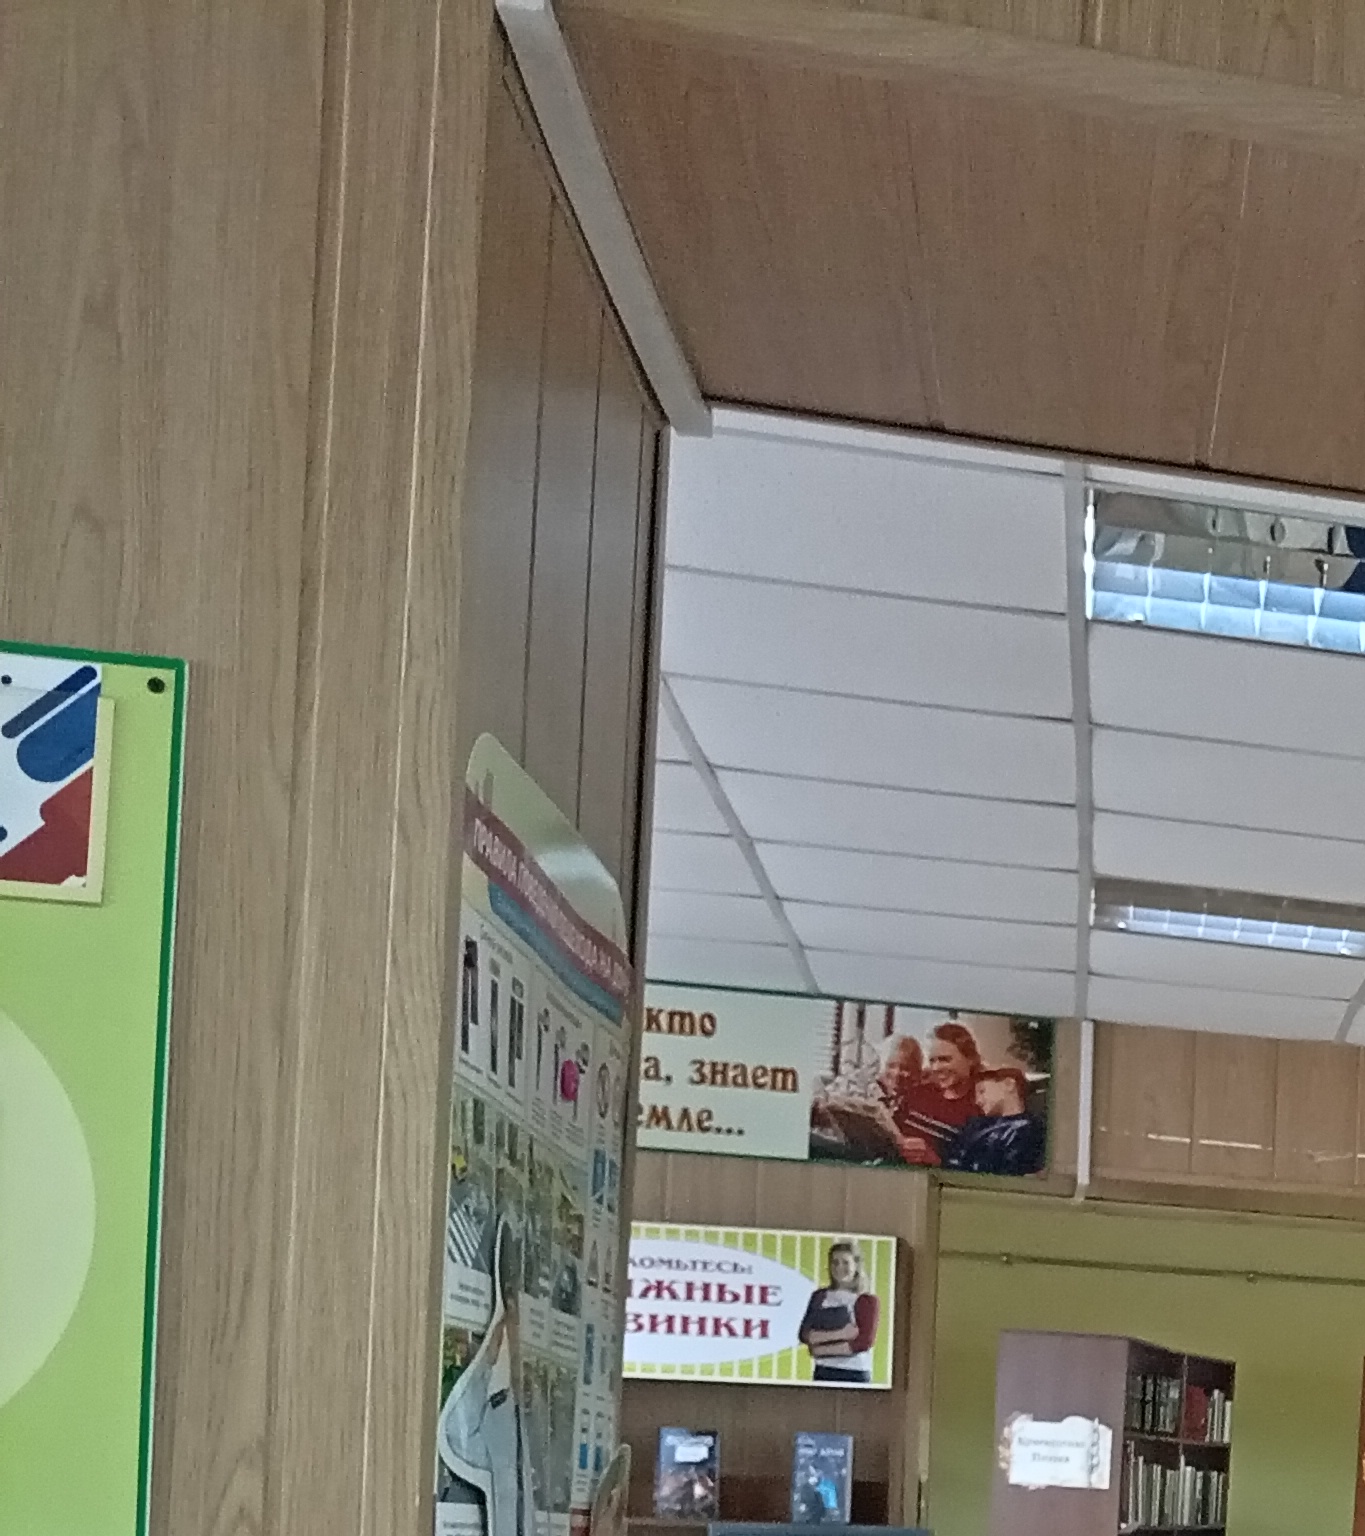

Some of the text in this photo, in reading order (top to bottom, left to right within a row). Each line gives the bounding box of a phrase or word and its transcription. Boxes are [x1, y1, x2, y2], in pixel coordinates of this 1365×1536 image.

[645, 1007, 717, 1036] кто
[689, 1058, 799, 1093] знает
[639, 1103, 745, 1137] мле...
[629, 1278, 783, 1307] ЖНЫЕ
